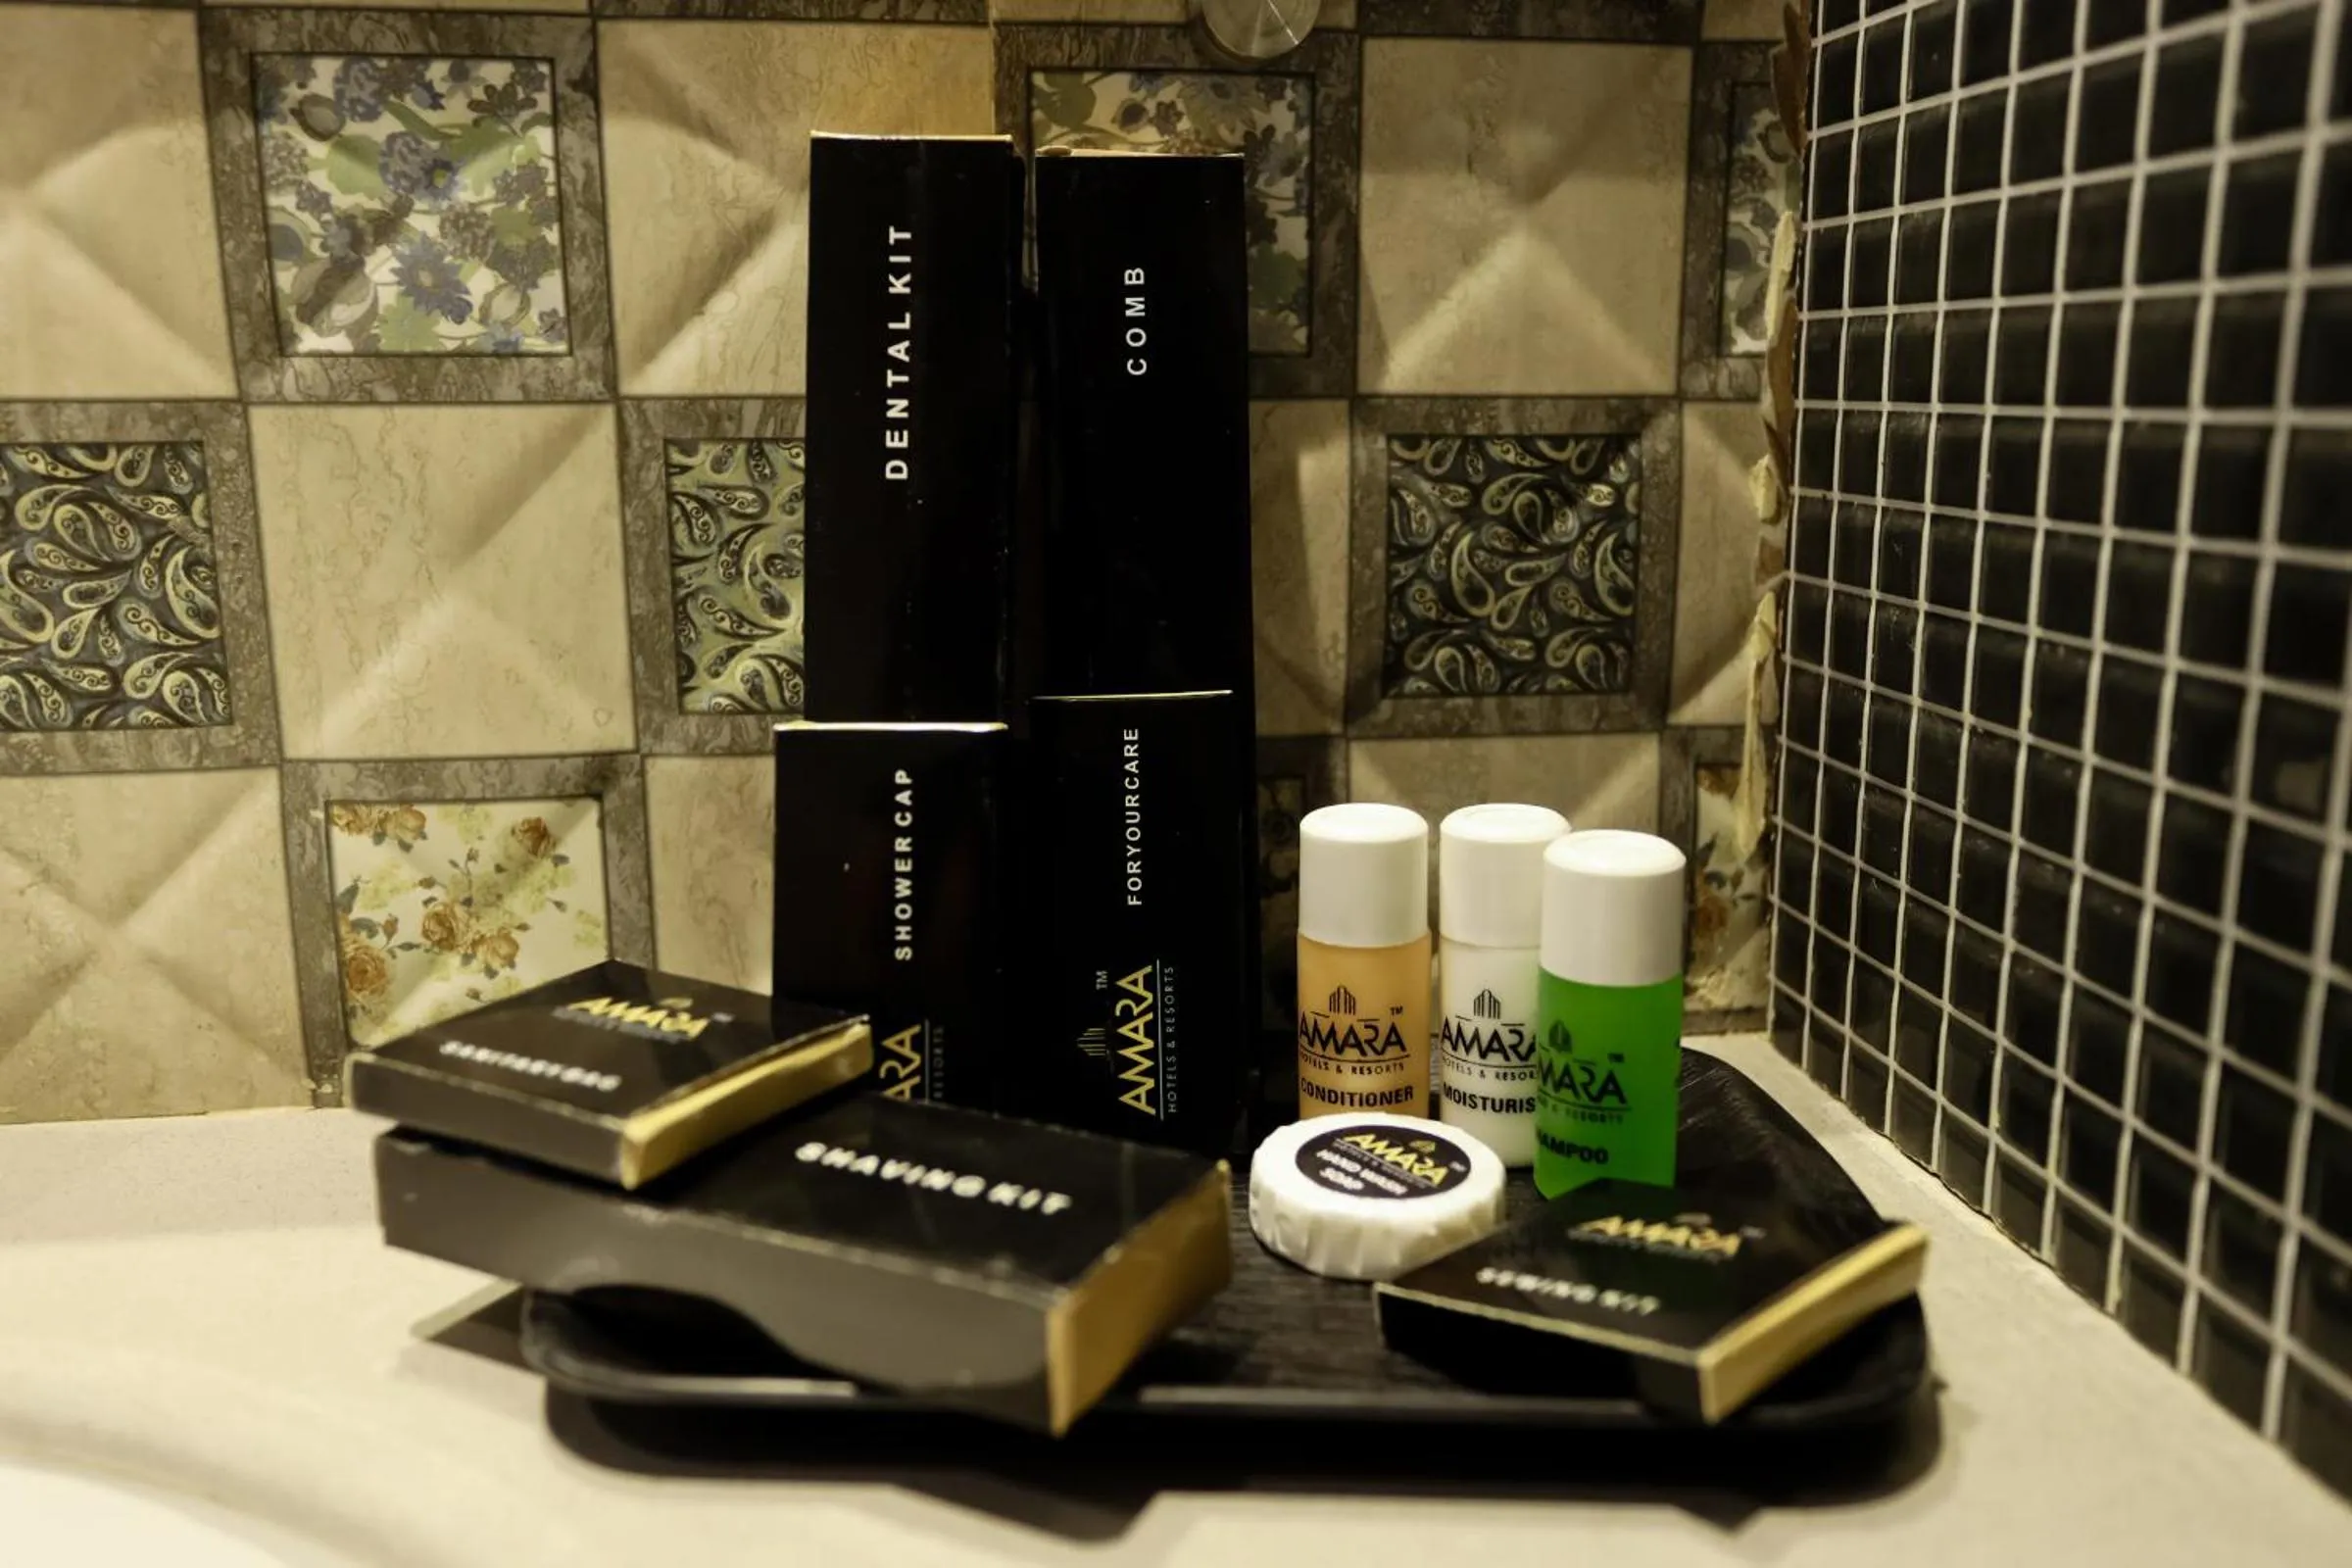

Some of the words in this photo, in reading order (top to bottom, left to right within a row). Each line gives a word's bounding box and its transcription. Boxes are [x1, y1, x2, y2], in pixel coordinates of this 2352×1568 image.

[888, 226, 912, 294] KIT
[1124, 267, 1148, 375] COMB
[886, 312, 911, 480] DENTAL
[894, 769, 913, 827] CAP
[894, 837, 913, 961] SHOWER
[1164, 966, 1176, 1033] RESORTS
[1115, 964, 1156, 1116] AMARA
[1299, 1010, 1407, 1056] AMARA
[879, 1023, 922, 1102] ARA
[1166, 1055, 1177, 1113] HOTELS
[1350, 1062, 1405, 1076] RESORTS
[1494, 1070, 1536, 1082] RESOR
[1538, 1055, 1628, 1104] MARA
[1300, 1077, 1414, 1107] CONDITIONER
[1443, 1082, 1537, 1114] MOISTURIS
[1343, 1133, 1449, 1186] AMARA
[1538, 1130, 1609, 1164] AMPOO
[794, 1141, 987, 1199] SHAVING
[987, 1181, 1073, 1216] KIT
